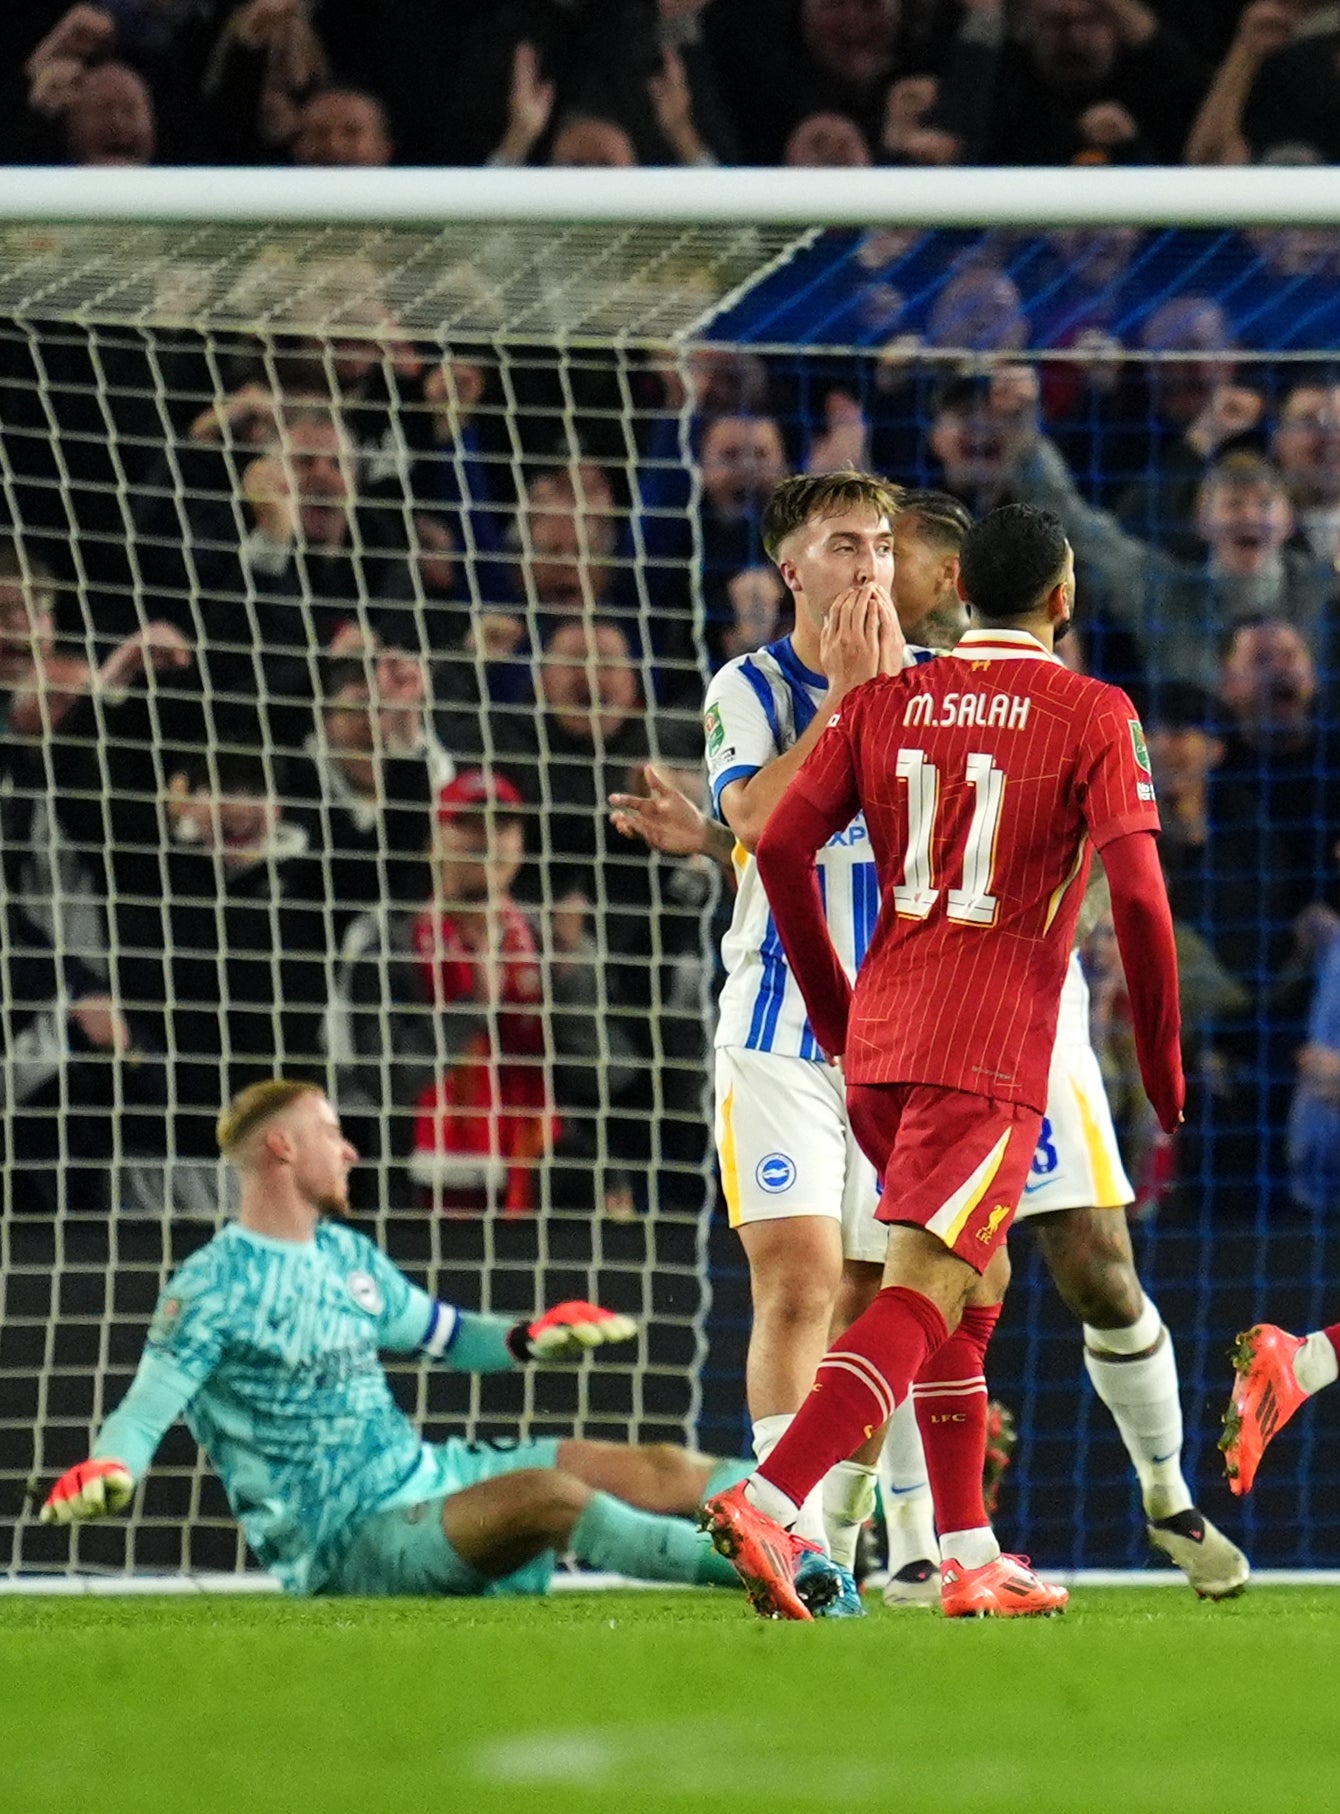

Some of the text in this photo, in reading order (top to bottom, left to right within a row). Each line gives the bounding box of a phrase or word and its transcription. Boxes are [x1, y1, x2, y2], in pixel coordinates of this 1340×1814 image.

[902, 692, 1031, 731] M.SALAH
[893, 748, 1008, 928] 11
[931, 1413, 967, 1424] LFC
